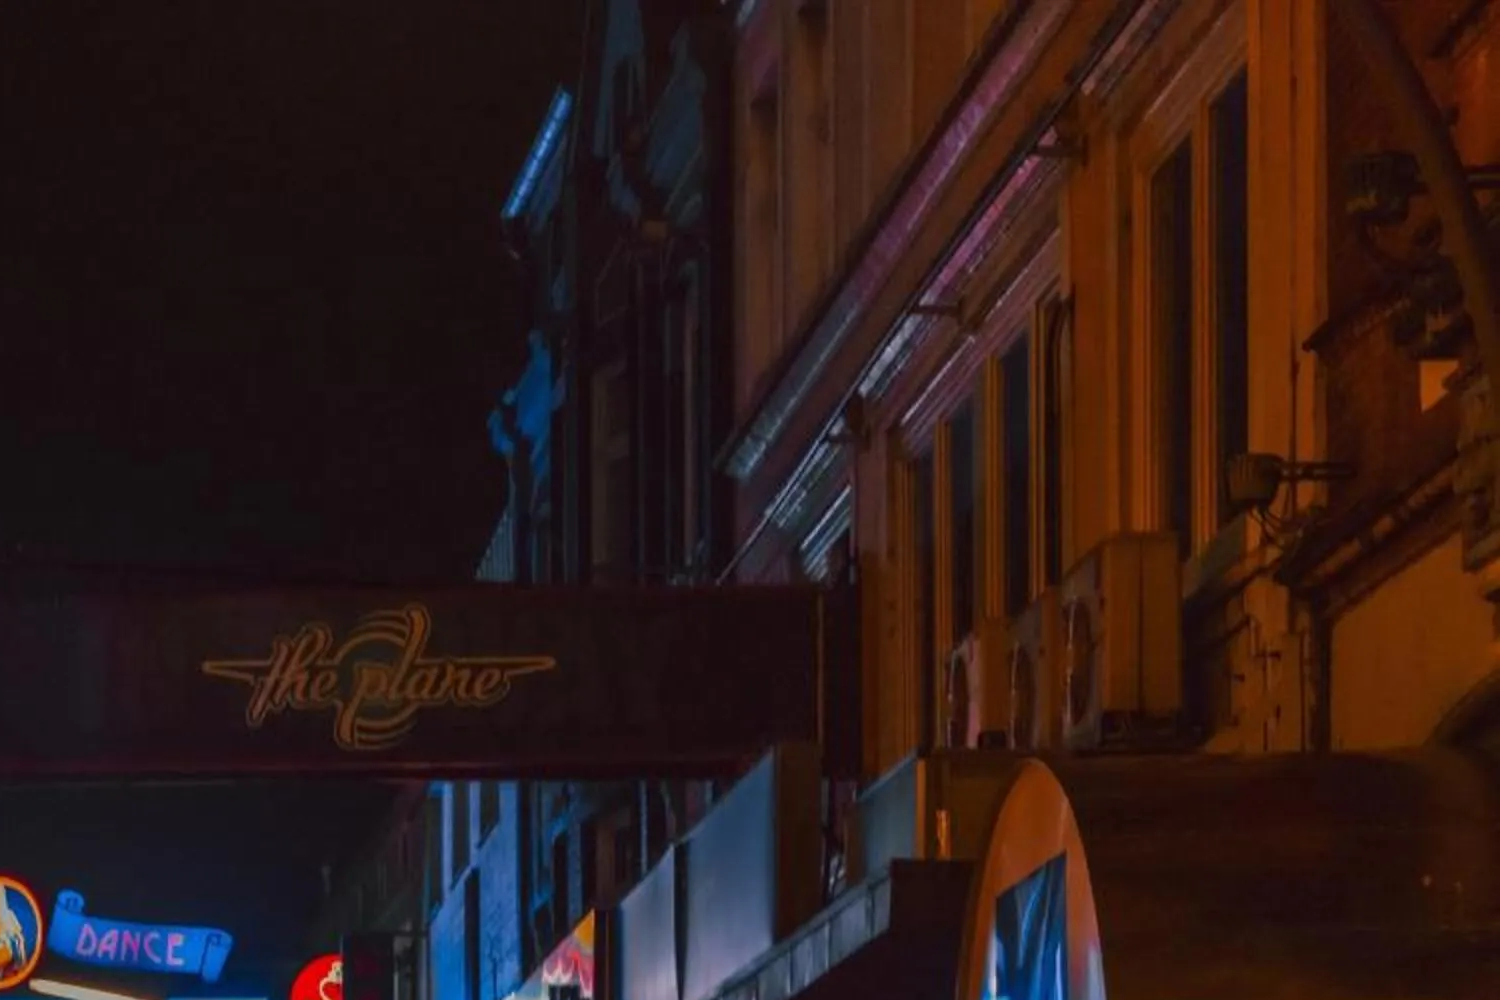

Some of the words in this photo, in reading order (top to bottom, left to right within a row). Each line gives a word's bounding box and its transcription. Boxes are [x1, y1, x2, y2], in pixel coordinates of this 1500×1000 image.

[246, 623, 339, 729] the
[334, 602, 512, 750] plane
[77, 922, 185, 966] DANCE
